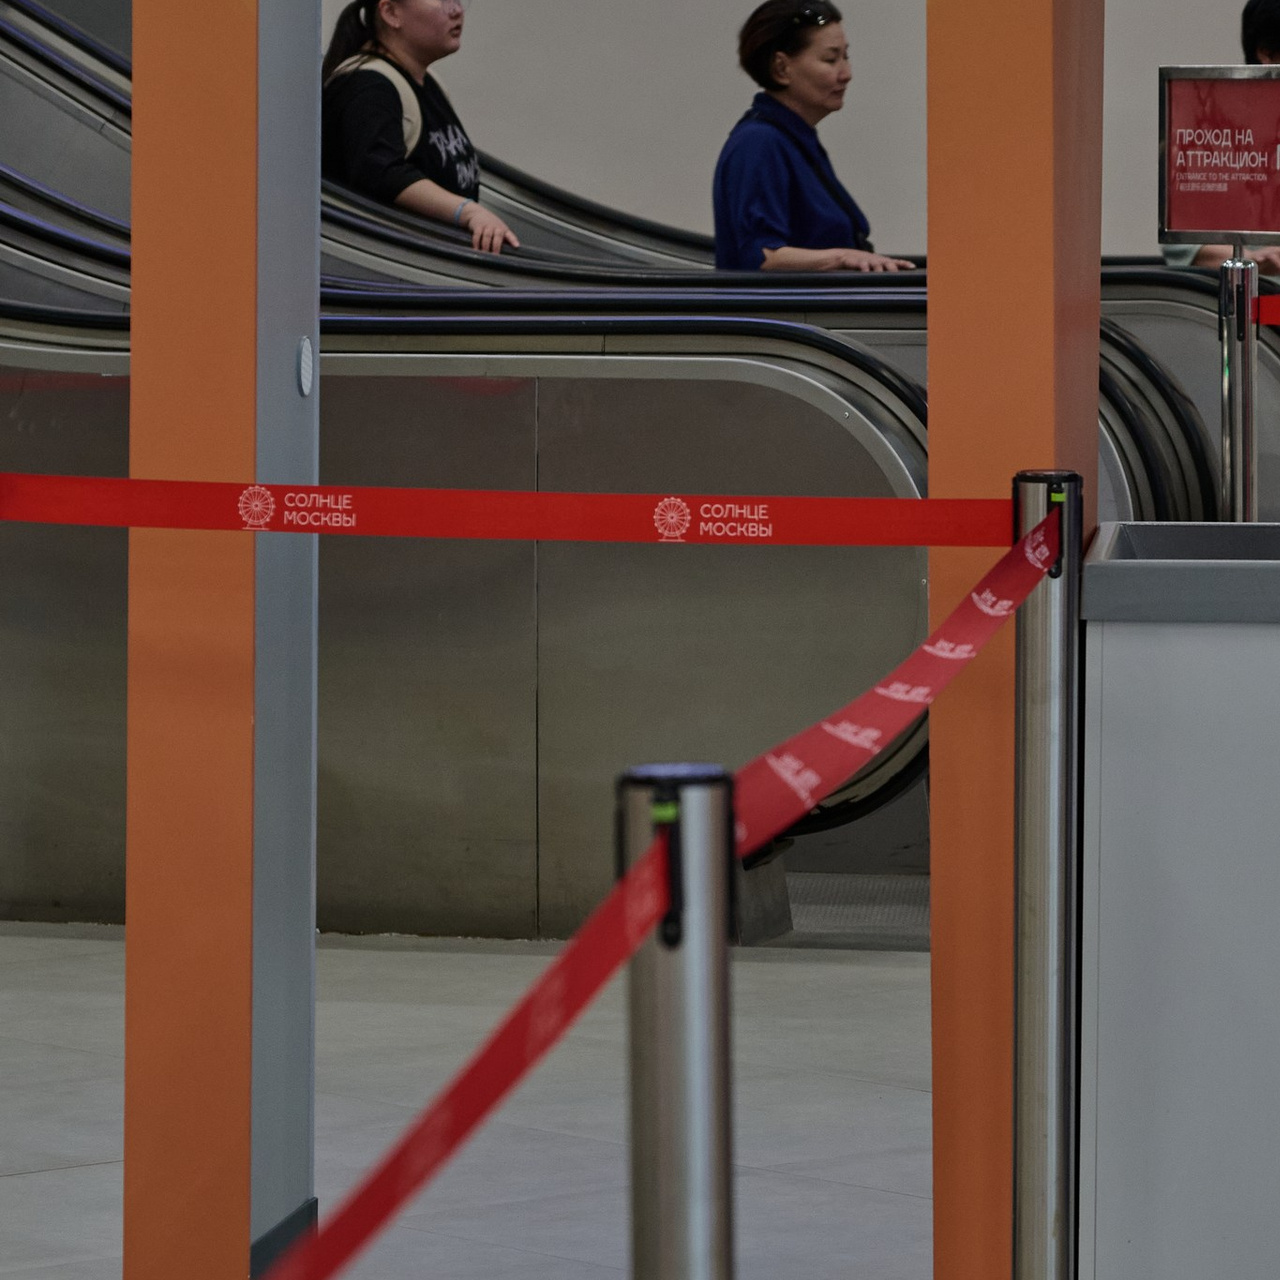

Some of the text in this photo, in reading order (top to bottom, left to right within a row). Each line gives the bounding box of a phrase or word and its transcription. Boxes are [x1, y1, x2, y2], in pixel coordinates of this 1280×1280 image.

[1176, 129, 1254, 148] ПРОХОД НА
[1176, 151, 1268, 170] АТТРАКЦИОН
[284, 493, 352, 510] СОЛНЦЕ
[284, 511, 356, 527] МОСКВЫ
[700, 504, 769, 520] СОЛНЦЕ
[700, 522, 773, 537] МОСКВЫ
